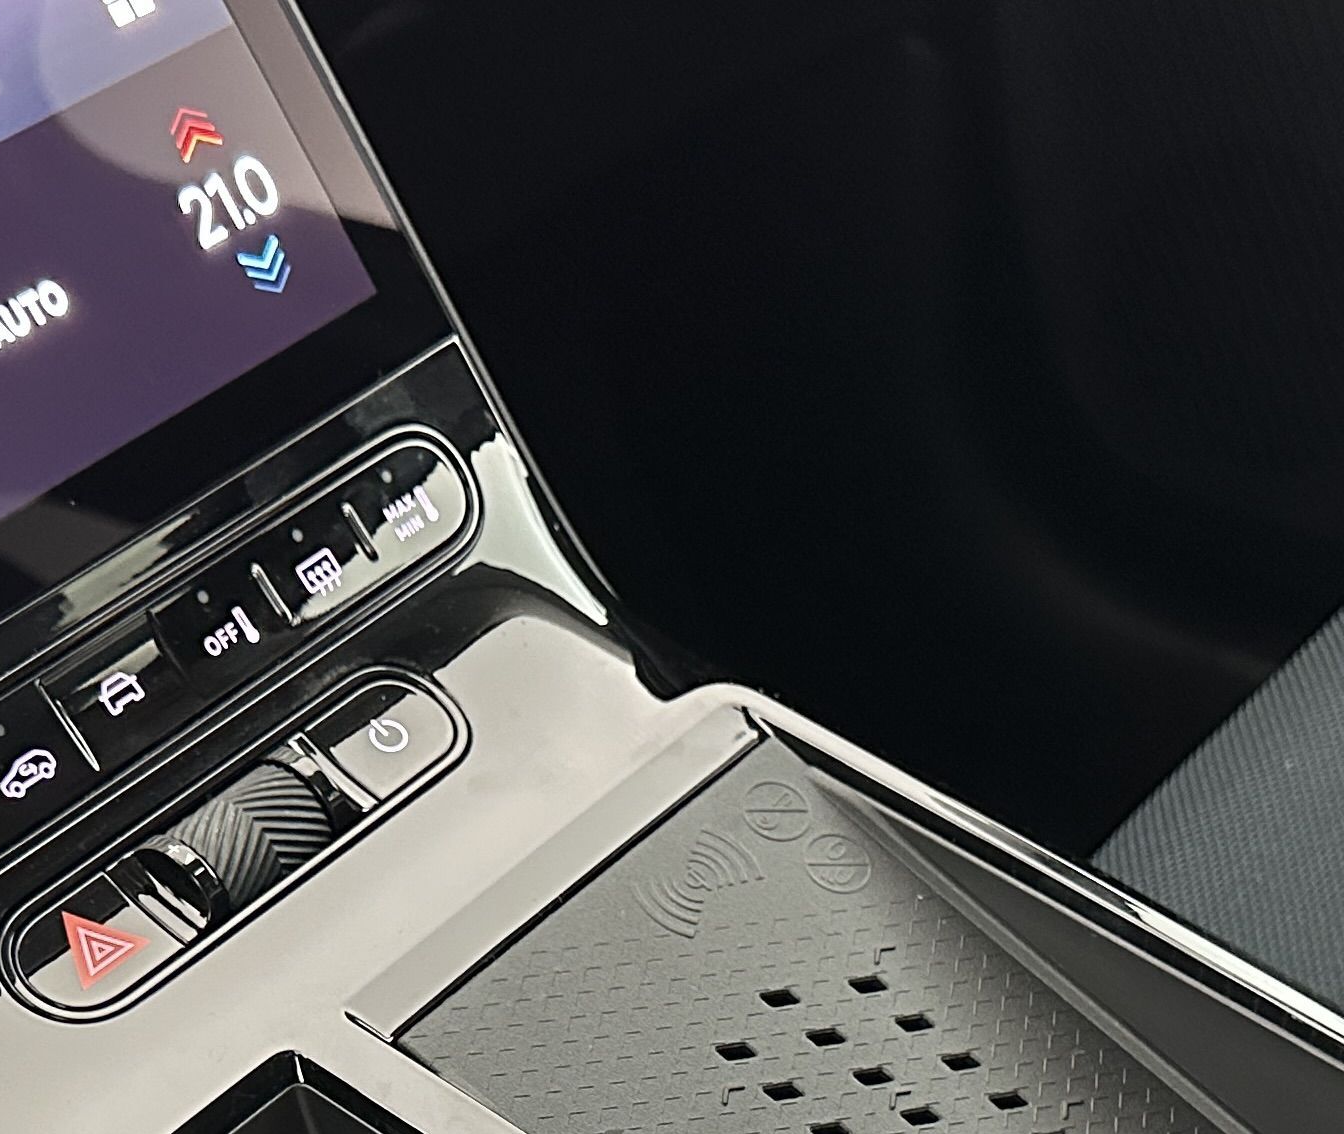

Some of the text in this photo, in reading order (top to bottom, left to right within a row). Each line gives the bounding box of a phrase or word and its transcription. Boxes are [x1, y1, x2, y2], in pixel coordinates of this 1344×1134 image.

[178, 155, 279, 250] 21.0
[382, 492, 416, 524] MAX
[394, 515, 425, 542] MIN
[203, 622, 239, 657] OFF
